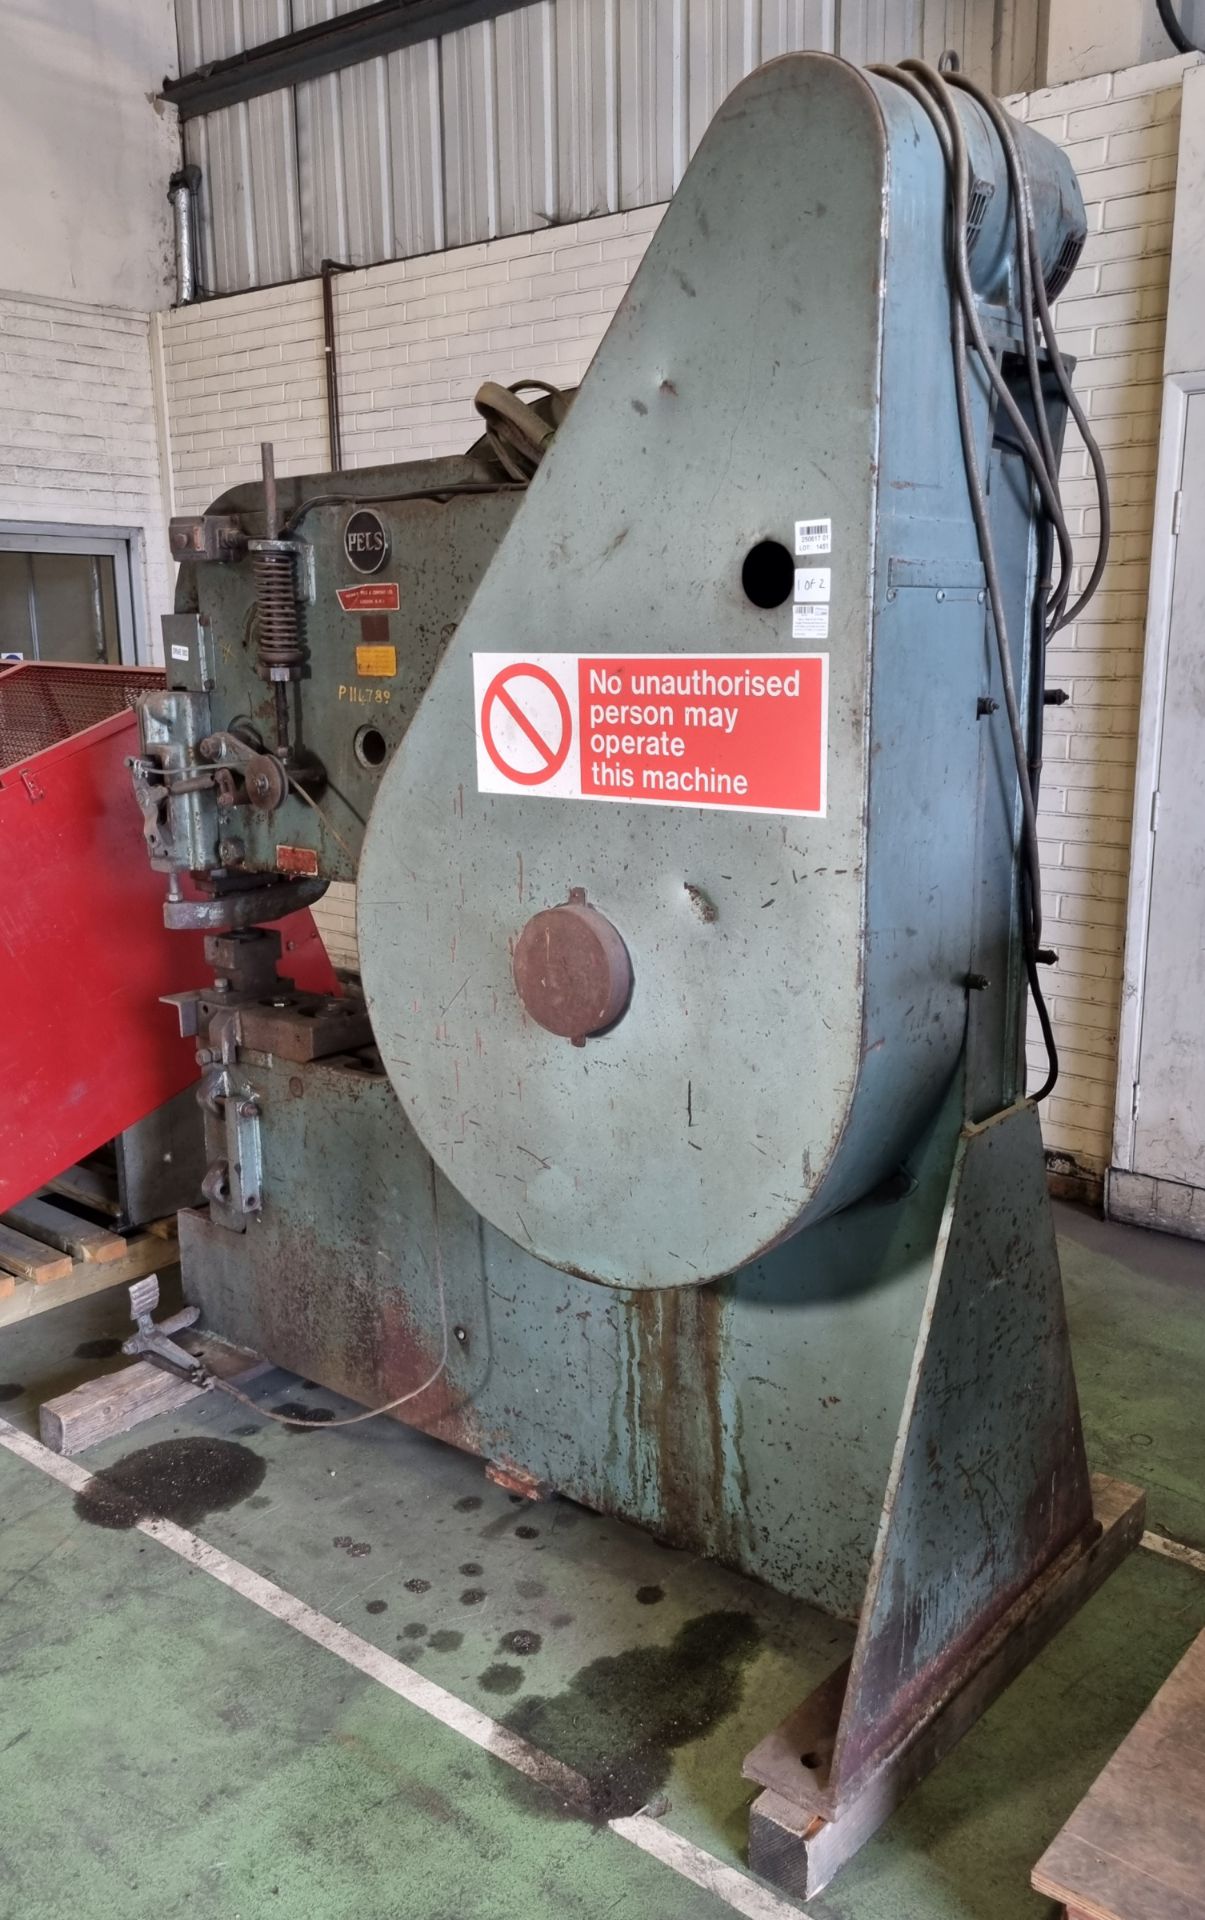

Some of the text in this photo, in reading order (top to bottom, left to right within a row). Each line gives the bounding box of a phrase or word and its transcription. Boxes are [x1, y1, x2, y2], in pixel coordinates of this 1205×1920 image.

[348, 531, 383, 552] PELS
[819, 578, 826, 589] 2
[589, 669, 800, 697] No unauthorised
[590, 704, 738, 734] person may
[590, 731, 685, 758] operate
[591, 761, 748, 795] this machine
